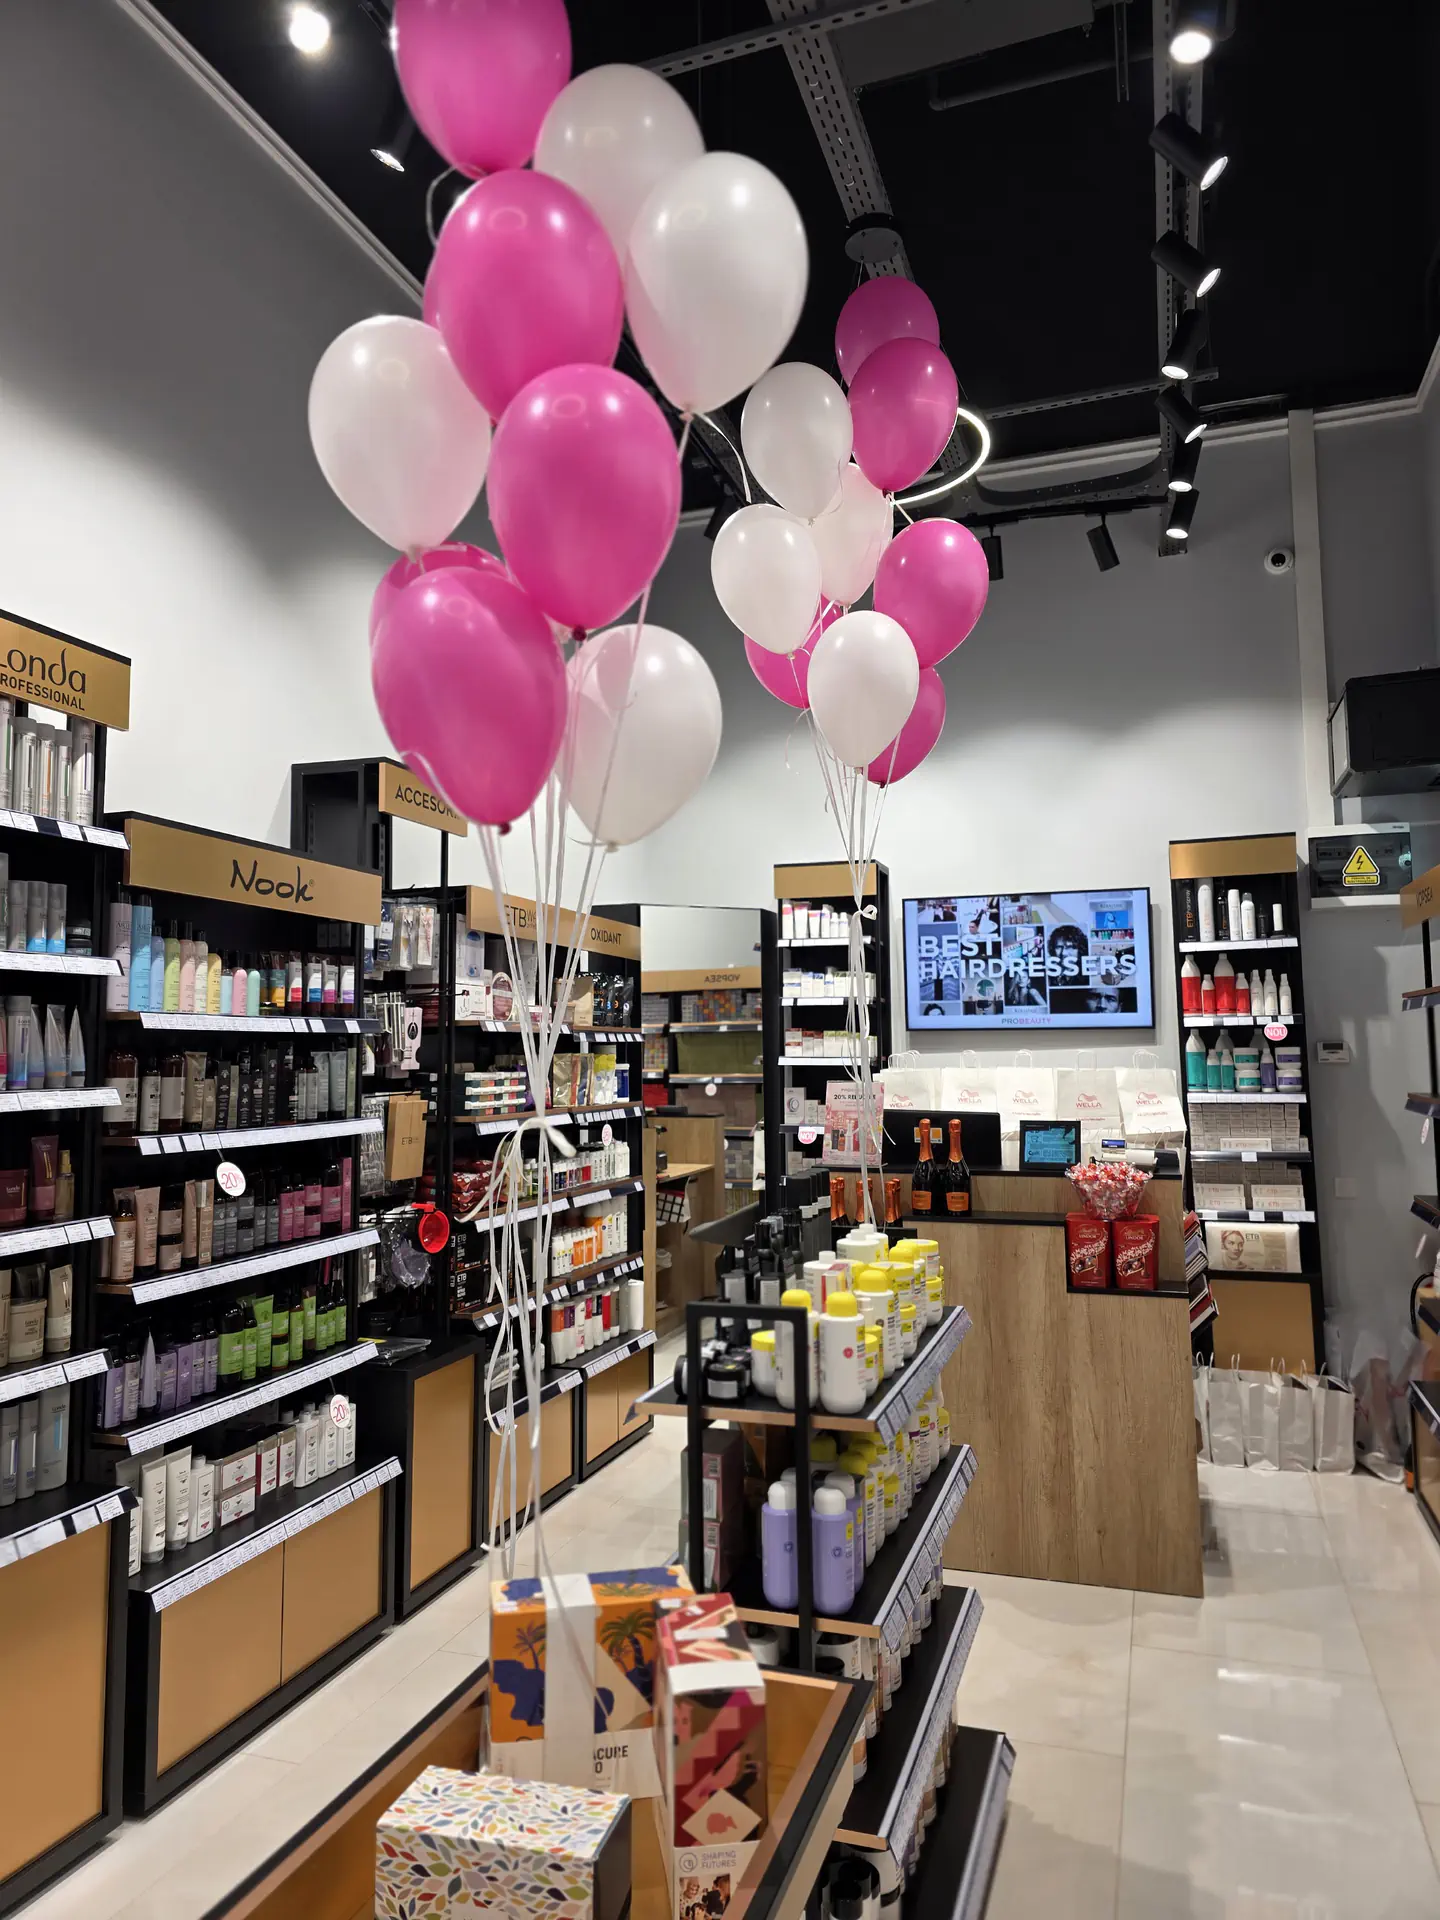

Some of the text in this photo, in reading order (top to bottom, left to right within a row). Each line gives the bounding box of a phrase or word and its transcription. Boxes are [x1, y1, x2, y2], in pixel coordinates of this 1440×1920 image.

[0, 647, 86, 694] onda
[395, 784, 461, 820] ACCESO
[230, 859, 314, 903] Nook
[590, 927, 622, 946] OXIDANT
[920, 934, 999, 958] BEST
[920, 954, 1137, 980] HAIRDRESSERS
[1001, 1016, 1052, 1025] PROBEAUTY
[1265, 1027, 1287, 1037] NOU
[701, 1850, 737, 1861] SHAPING
[701, 1859, 737, 1869] FUTURES
